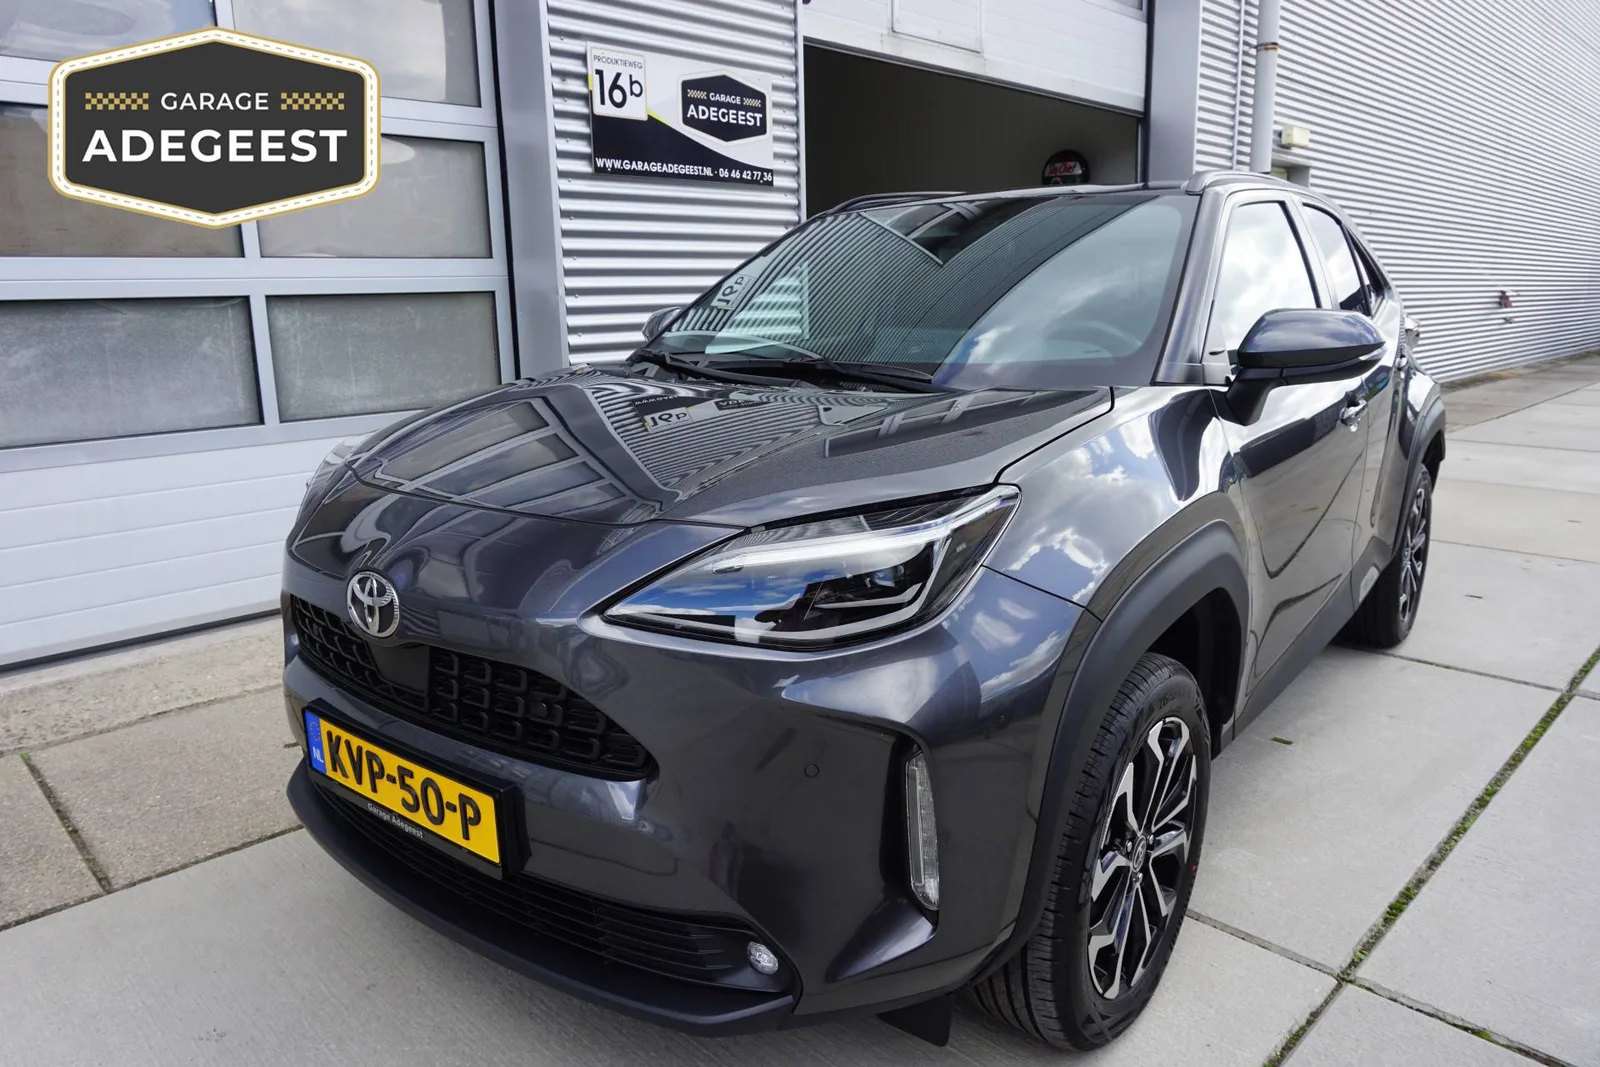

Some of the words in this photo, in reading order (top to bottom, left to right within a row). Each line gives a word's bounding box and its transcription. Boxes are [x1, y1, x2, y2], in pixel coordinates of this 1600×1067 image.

[593, 54, 643, 70] PRODUKTIEWEG
[595, 69, 643, 109] 16b
[709, 92, 741, 105] GARAGE
[687, 104, 763, 127] ADEGEEST
[595, 157, 713, 177] WWW.GARAGEADEGEEST.NL
[719, 169, 729, 178] 06
[730, 170, 741, 179] 46
[742, 170, 752, 180] 42
[752, 171, 762, 181] 77
[762, 172, 773, 181] 36
[312, 746, 324, 763] NL
[326, 730, 481, 841] KVP-50-P
[367, 803, 391, 821] Garage
[391, 816, 423, 839] Adegeest
